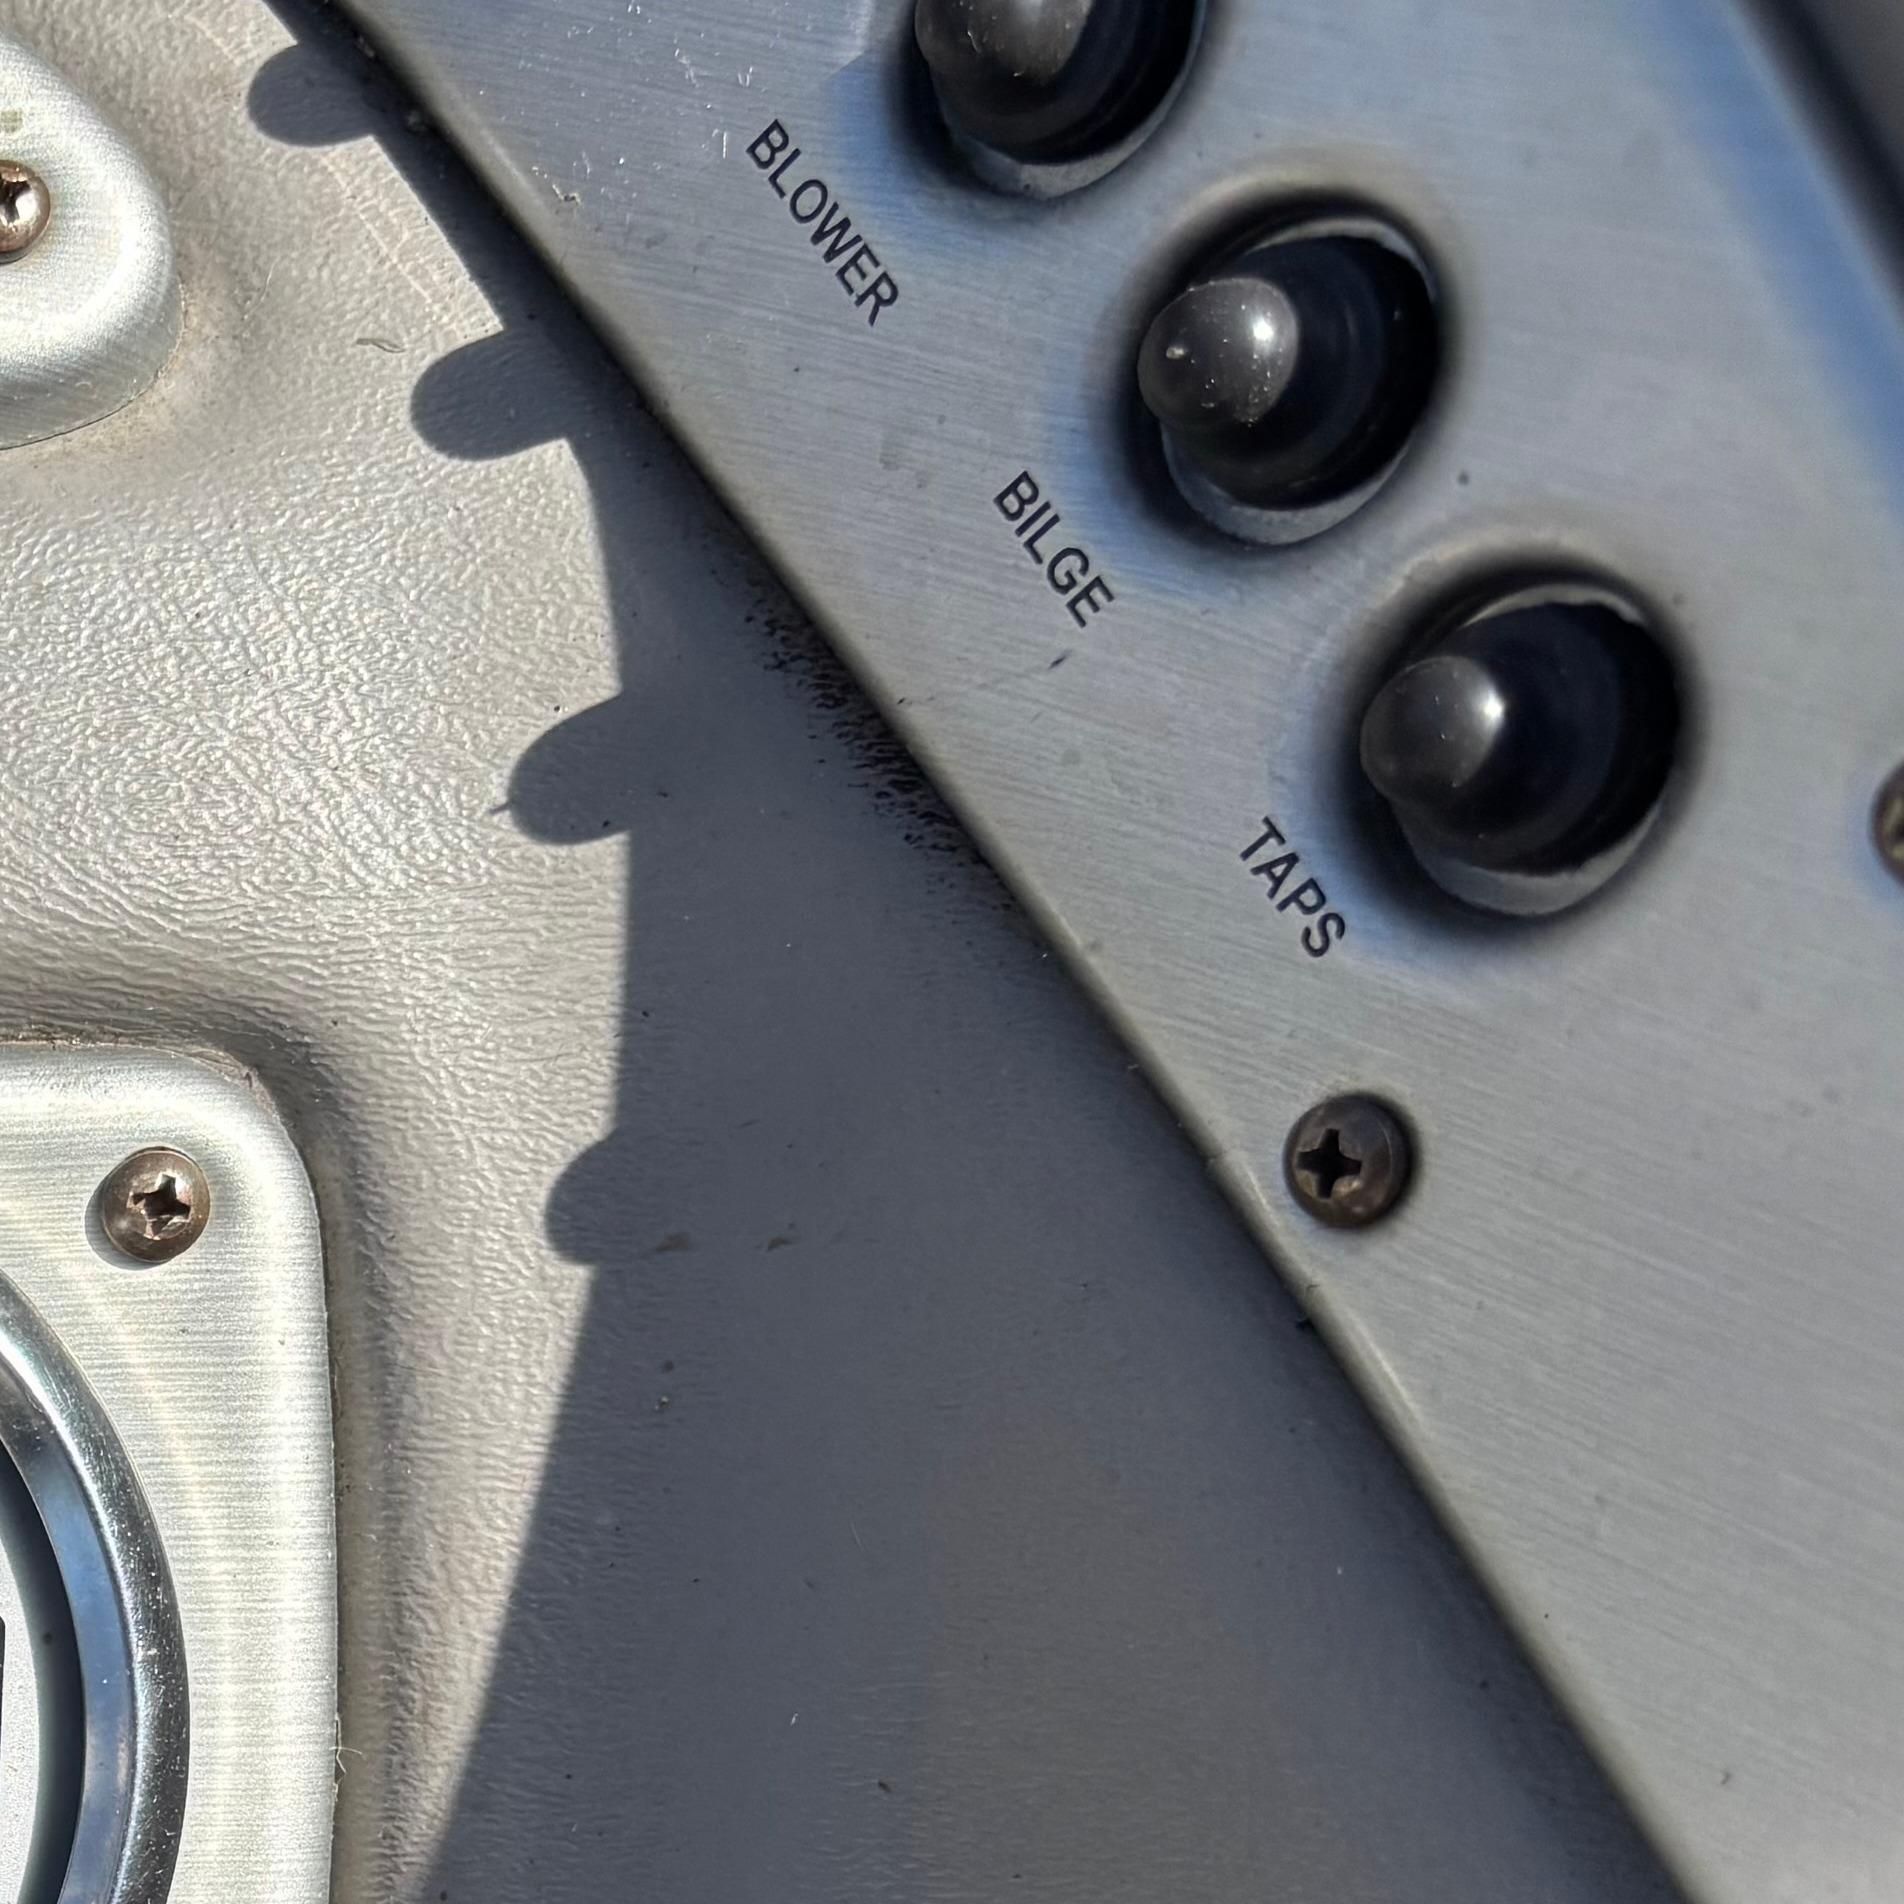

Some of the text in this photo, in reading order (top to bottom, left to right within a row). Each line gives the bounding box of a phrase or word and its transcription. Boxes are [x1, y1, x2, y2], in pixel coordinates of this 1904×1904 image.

[745, 119, 900, 326] BLOWER
[993, 470, 1114, 628] BILGE
[1239, 815, 1346, 959] TAPS
